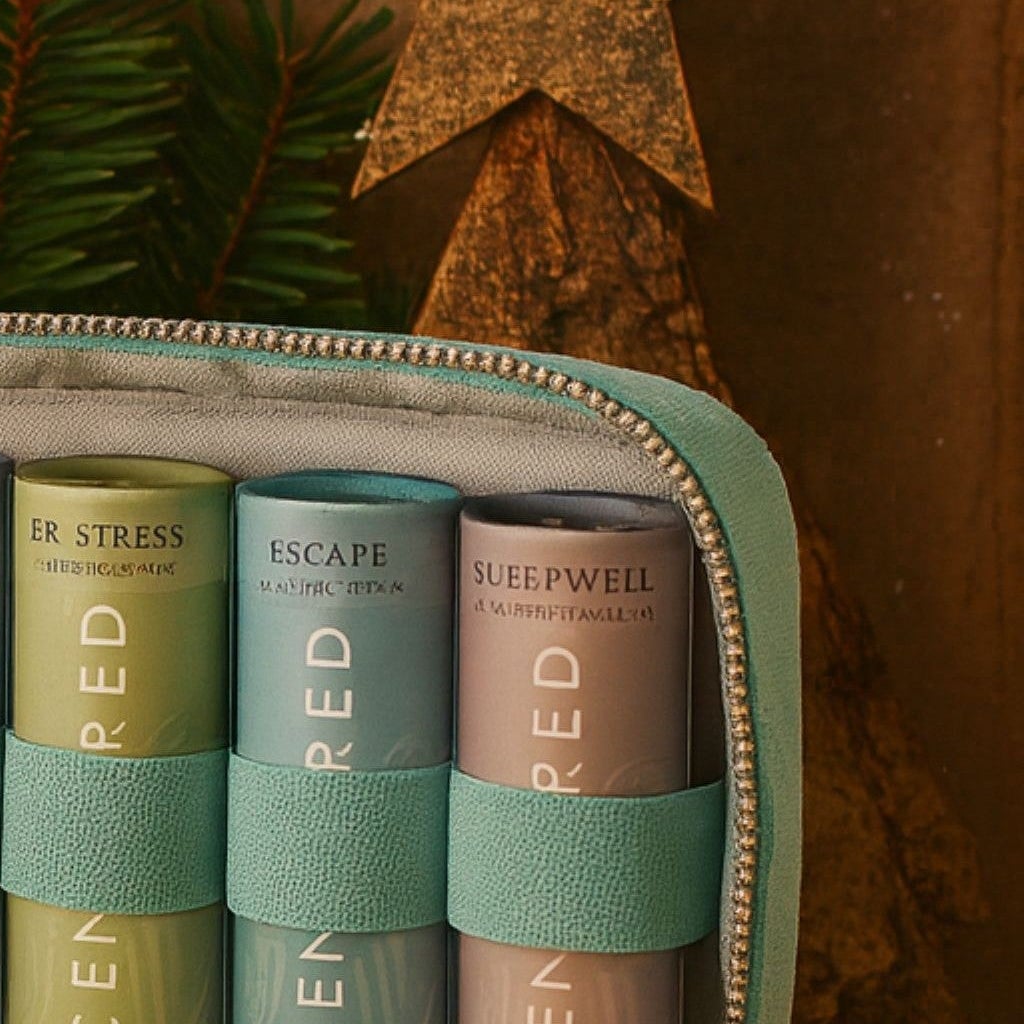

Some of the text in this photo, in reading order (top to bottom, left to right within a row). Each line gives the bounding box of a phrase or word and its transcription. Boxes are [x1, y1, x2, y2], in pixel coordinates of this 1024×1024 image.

[30, 517, 185, 549] ER STRESS
[270, 539, 388, 568] ESCAPE
